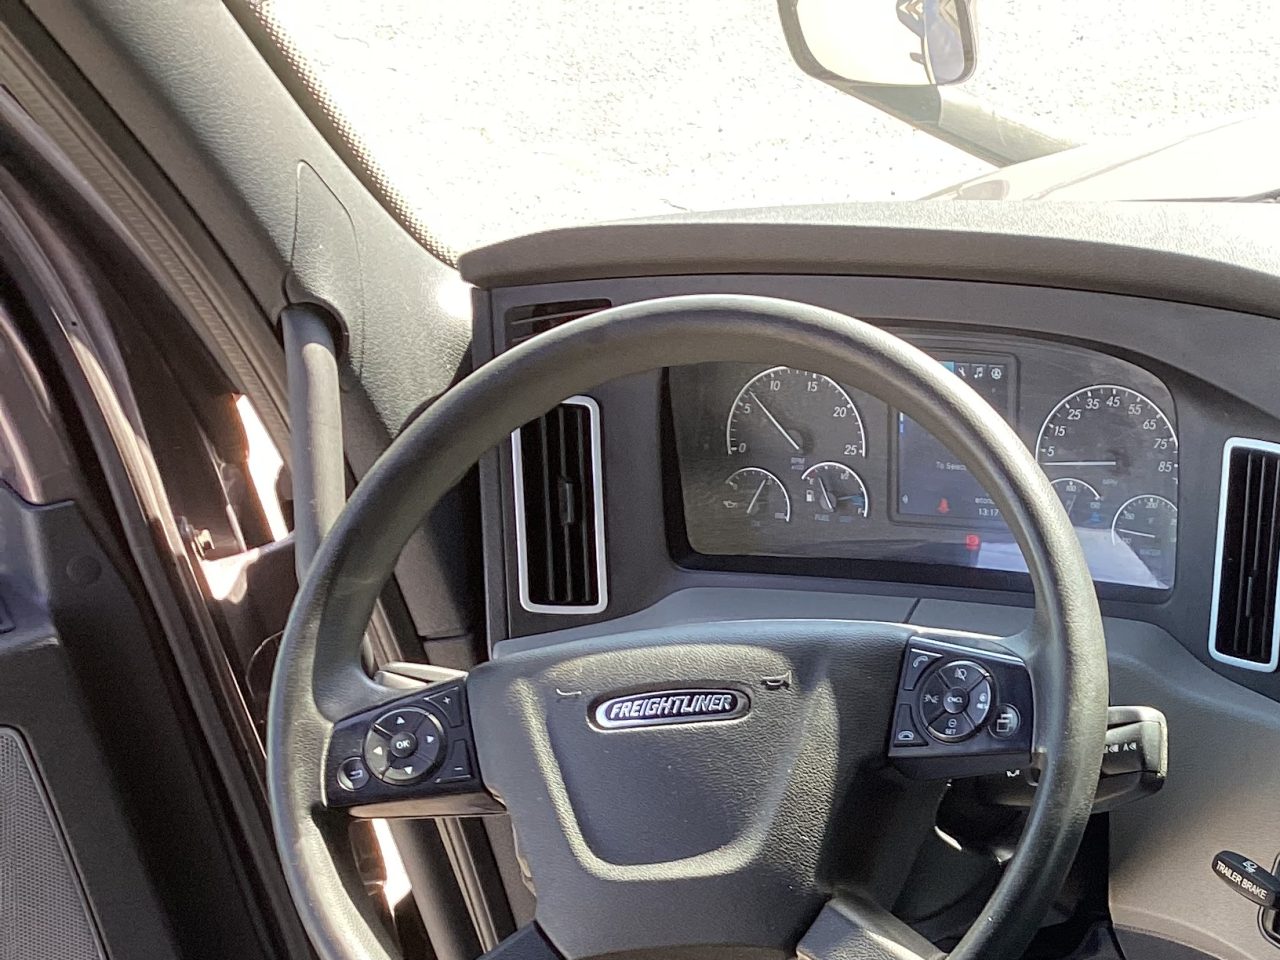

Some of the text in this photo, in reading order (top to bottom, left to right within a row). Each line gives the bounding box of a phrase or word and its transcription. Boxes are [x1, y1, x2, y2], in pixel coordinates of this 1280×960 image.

[770, 381, 780, 391] 10
[807, 382, 818, 392] 15
[1085, 398, 1100, 409] 35
[1106, 396, 1121, 407] 45
[743, 404, 750, 414] 5
[833, 406, 847, 417] 20
[1067, 409, 1082, 420] 25
[1127, 404, 1142, 415] 55
[1142, 419, 1157, 430] 65
[1054, 425, 1066, 437] 15
[738, 442, 747, 453] 0
[1153, 438, 1168, 449] 75
[843, 444, 858, 455] 25
[1046, 446, 1055, 457] 5
[1157, 461, 1172, 473] 85
[978, 507, 1001, 518] 13:17
[609, 694, 733, 719] FREIGHTLINER
[395, 739, 411, 749] OK
[1216, 860, 1268, 900] TRAILER BRAKE
